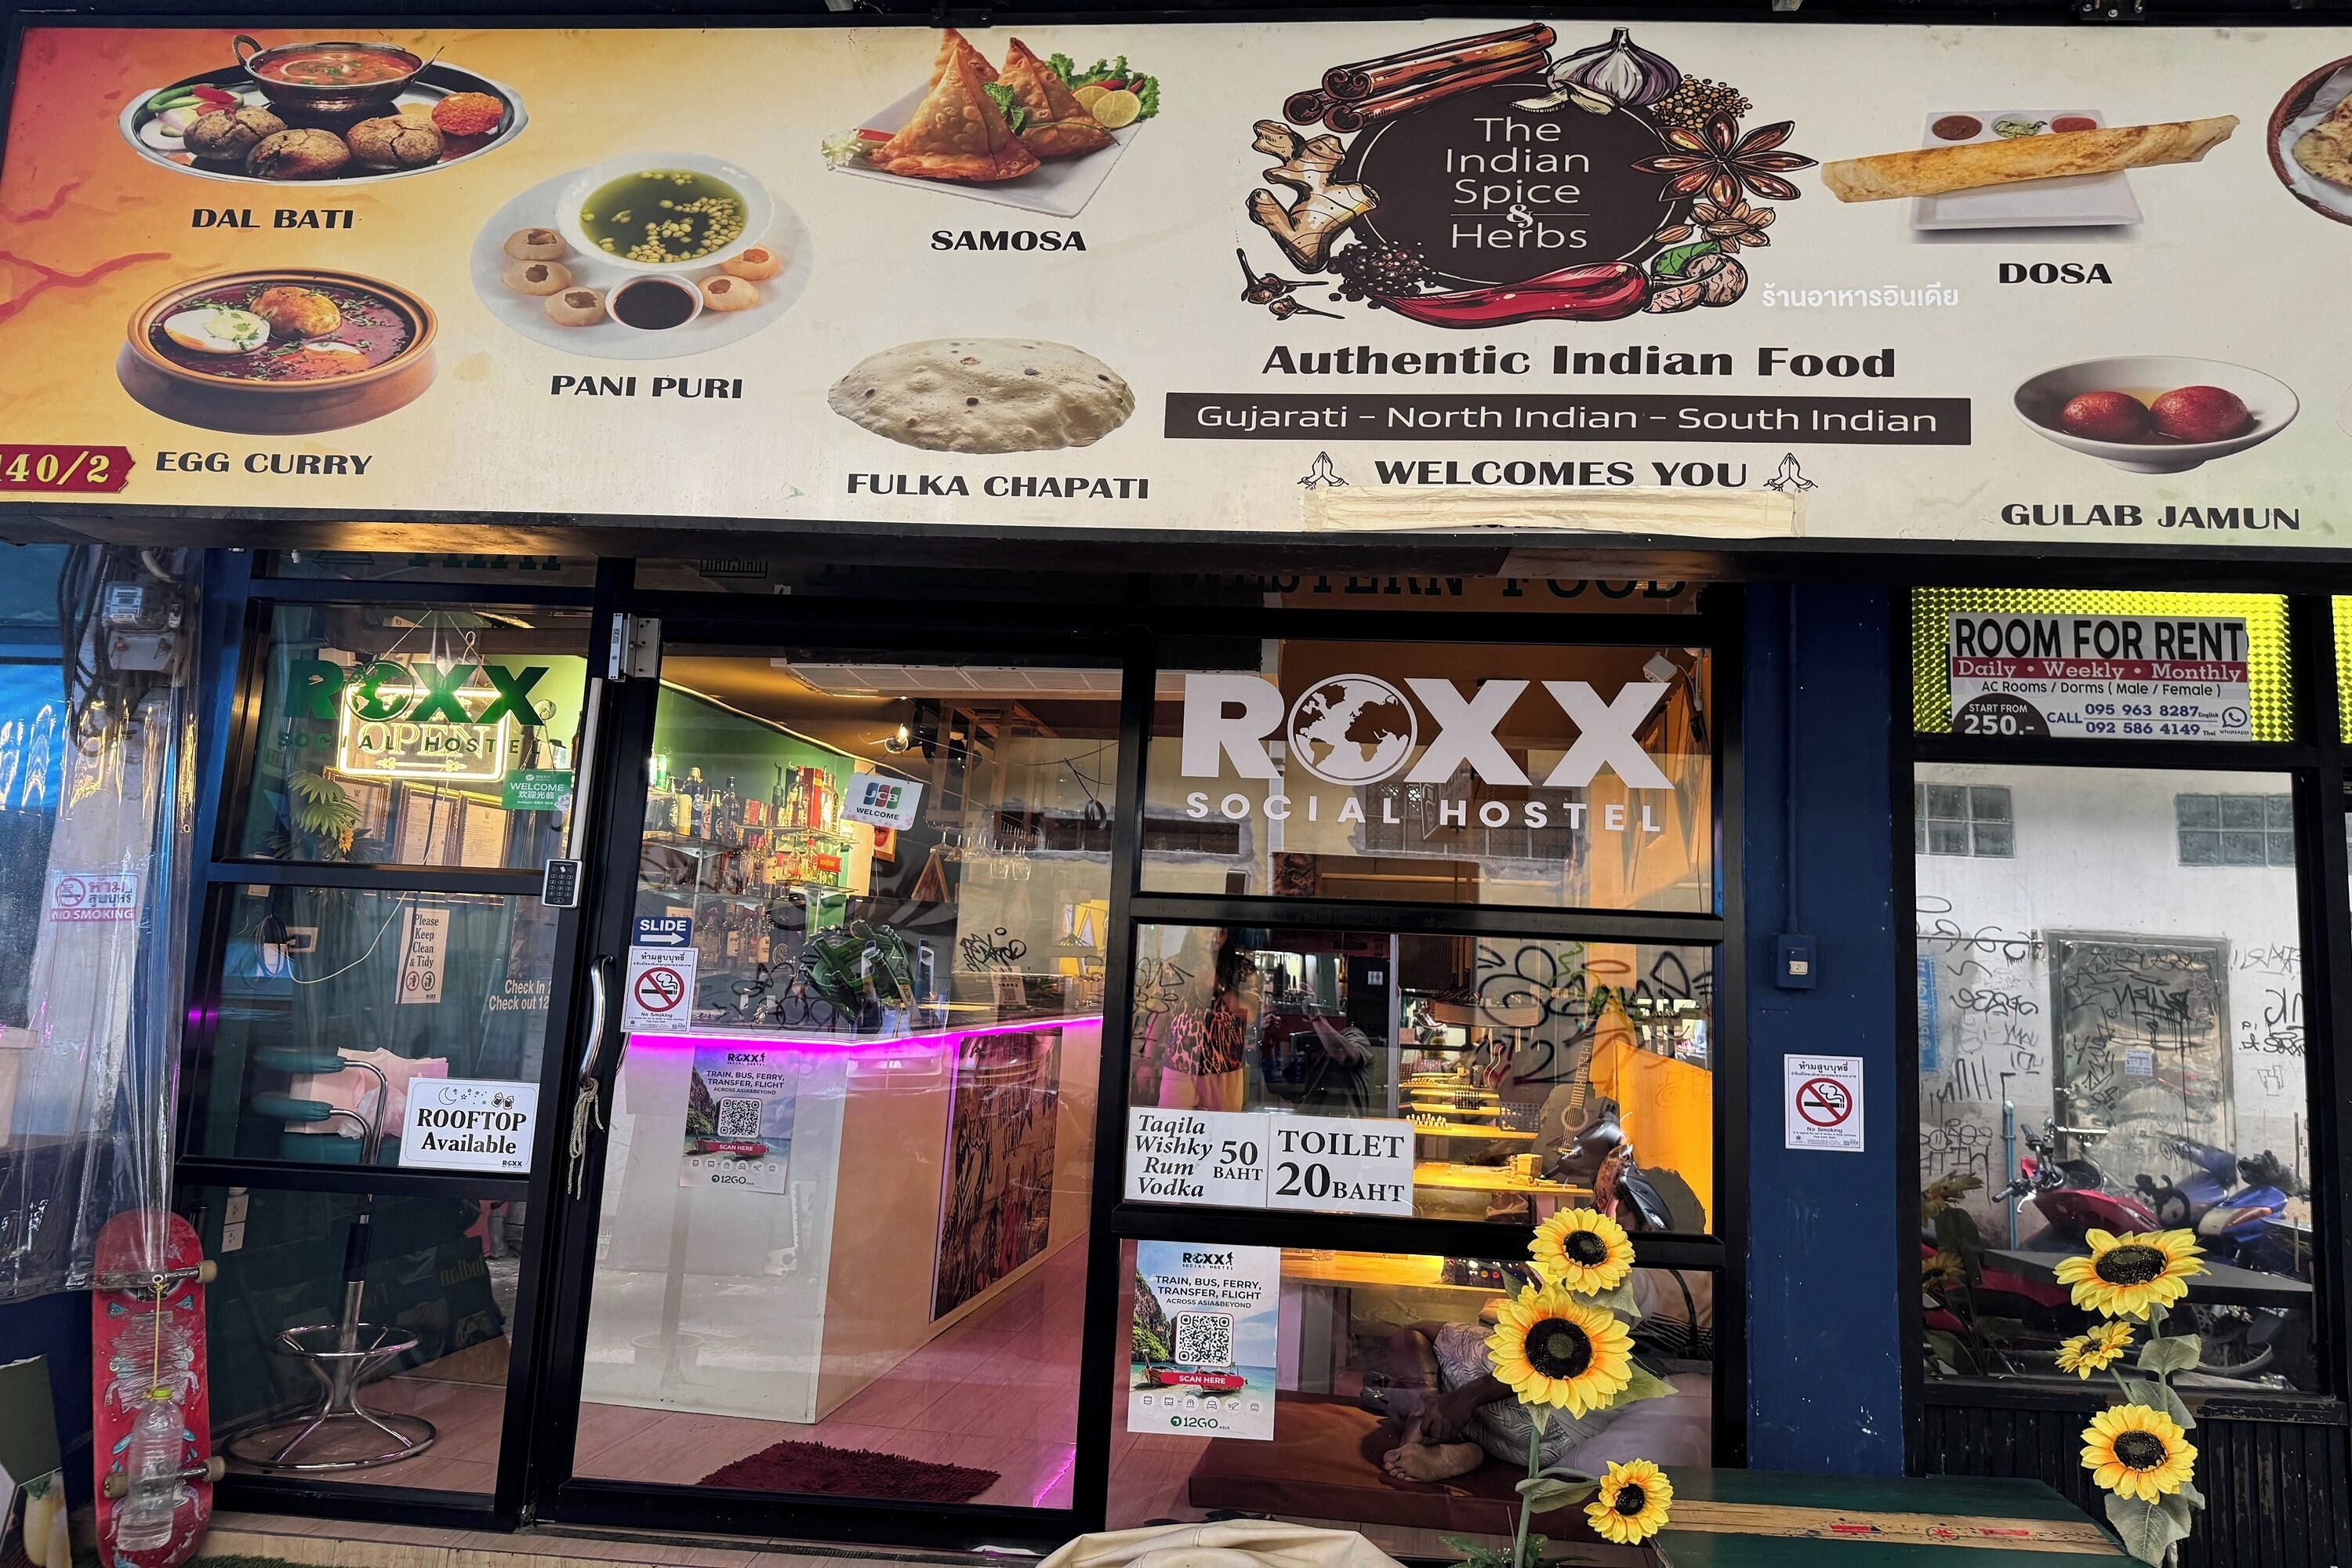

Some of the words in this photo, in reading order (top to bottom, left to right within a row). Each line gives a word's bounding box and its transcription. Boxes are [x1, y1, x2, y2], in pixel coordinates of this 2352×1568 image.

[1474, 117, 1561, 143] The
[1446, 148, 1590, 173] Indian
[1454, 179, 1581, 207] Spice
[191, 209, 261, 229] DAL
[274, 209, 354, 230] BATI
[1506, 204, 1534, 227] &
[931, 230, 1087, 252] SAMOSA
[1451, 223, 1588, 249] Herbs
[1998, 263, 2113, 285] DOSA
[1762, 282, 1958, 307] ร้านอาหารอินเดีย
[1262, 343, 1531, 377] Authentic
[1552, 345, 1733, 377] Indian
[1757, 347, 1896, 378] Food
[550, 375, 637, 397] PANI
[652, 376, 744, 399] PURI
[1196, 405, 1349, 431] Gujarati
[1387, 405, 1503, 429] North
[1515, 406, 1639, 430] Indian
[1678, 407, 1798, 430] South
[1811, 408, 1937, 432] Indian
[155, 451, 230, 473] EGG
[244, 452, 374, 475] CURRY
[1374, 459, 1635, 488] WELCOMES
[1652, 461, 1748, 488] YOU
[847, 473, 970, 496] FULKA
[983, 476, 1150, 499] CHAPATI
[2001, 503, 2143, 527] GULAB
[2157, 505, 2299, 530] JAMUN
[1956, 618, 2063, 659] ROOM
[2074, 620, 2143, 659] FOR
[2154, 622, 2244, 661] RENT
[1958, 659, 2017, 678] Daily
[2042, 661, 2124, 681] Weekly
[2151, 662, 2242, 683] Monthly
[1982, 681, 2000, 693] AC
[2002, 681, 2047, 694] Rooms
[2061, 682, 2103, 695] Dorms
[2117, 683, 2149, 695] Male
[2162, 684, 2212, 697] Female
[1969, 703, 1998, 713] START
[2001, 704, 2027, 713] FROM
[2046, 712, 2083, 724] CALL
[2085, 703, 2115, 716] 095
[2122, 704, 2152, 717] 963
[2159, 705, 2199, 717] 8287
[1181, 673, 1675, 789] ROXX
[1964, 714, 2035, 735] 250.-
[2085, 721, 2116, 734] 092
[2123, 722, 2153, 735] 586
[2159, 723, 2201, 735] 4149
[356, 721, 491, 759] OPEN
[424, 735, 540, 756] HOSTEL
[510, 782, 564, 792] WELCOME
[518, 790, 555, 800] 欢迎光临
[863, 782, 901, 807] JCB
[856, 807, 900, 821] WELCOME
[1186, 792, 1400, 825] SOCIAL
[1439, 799, 1661, 833] HOSTEL
[73, 909, 134, 920] SMOKING
[415, 913, 439, 927] Please
[640, 919, 687, 931] SLIDE
[415, 927, 434, 941] Keep
[412, 941, 434, 954] Clean
[409, 957, 415, 967] &
[416, 955, 434, 969] Tidy
[505, 978, 534, 995] Check
[536, 980, 546, 993] In
[489, 995, 519, 1011] Check
[521, 996, 536, 1010] out
[728, 1053, 759, 1062] ROXX
[706, 1070, 733, 1079] TRAIN,
[756, 1073, 785, 1081] FERRY,
[708, 1078, 753, 1088] TRANSFER,
[754, 1080, 785, 1089] FLIGHT
[417, 1108, 527, 1131] ROOFTOP
[1138, 1114, 1206, 1138] Taqila
[421, 1131, 517, 1154] Available
[1134, 1135, 1213, 1158] Wishky
[1219, 1140, 1258, 1166] 50
[1277, 1129, 1405, 1158] TOILET
[1143, 1156, 1194, 1176] Rum
[1213, 1166, 1264, 1181] BAHT
[1138, 1177, 1205, 1197] Vodka
[1276, 1161, 1330, 1198] 20
[1331, 1181, 1406, 1202] BAHT
[1182, 1252, 1225, 1265] ROXX
[1156, 1276, 1191, 1287] TRAIN,
[1195, 1278, 1220, 1288] BUS,
[1223, 1279, 1261, 1290] FERRY,
[1157, 1287, 1218, 1298] TRANSFER,
[1221, 1290, 1261, 1300] FLIGHT
[1198, 1300, 1251, 1308] ASIA&BEYOND
